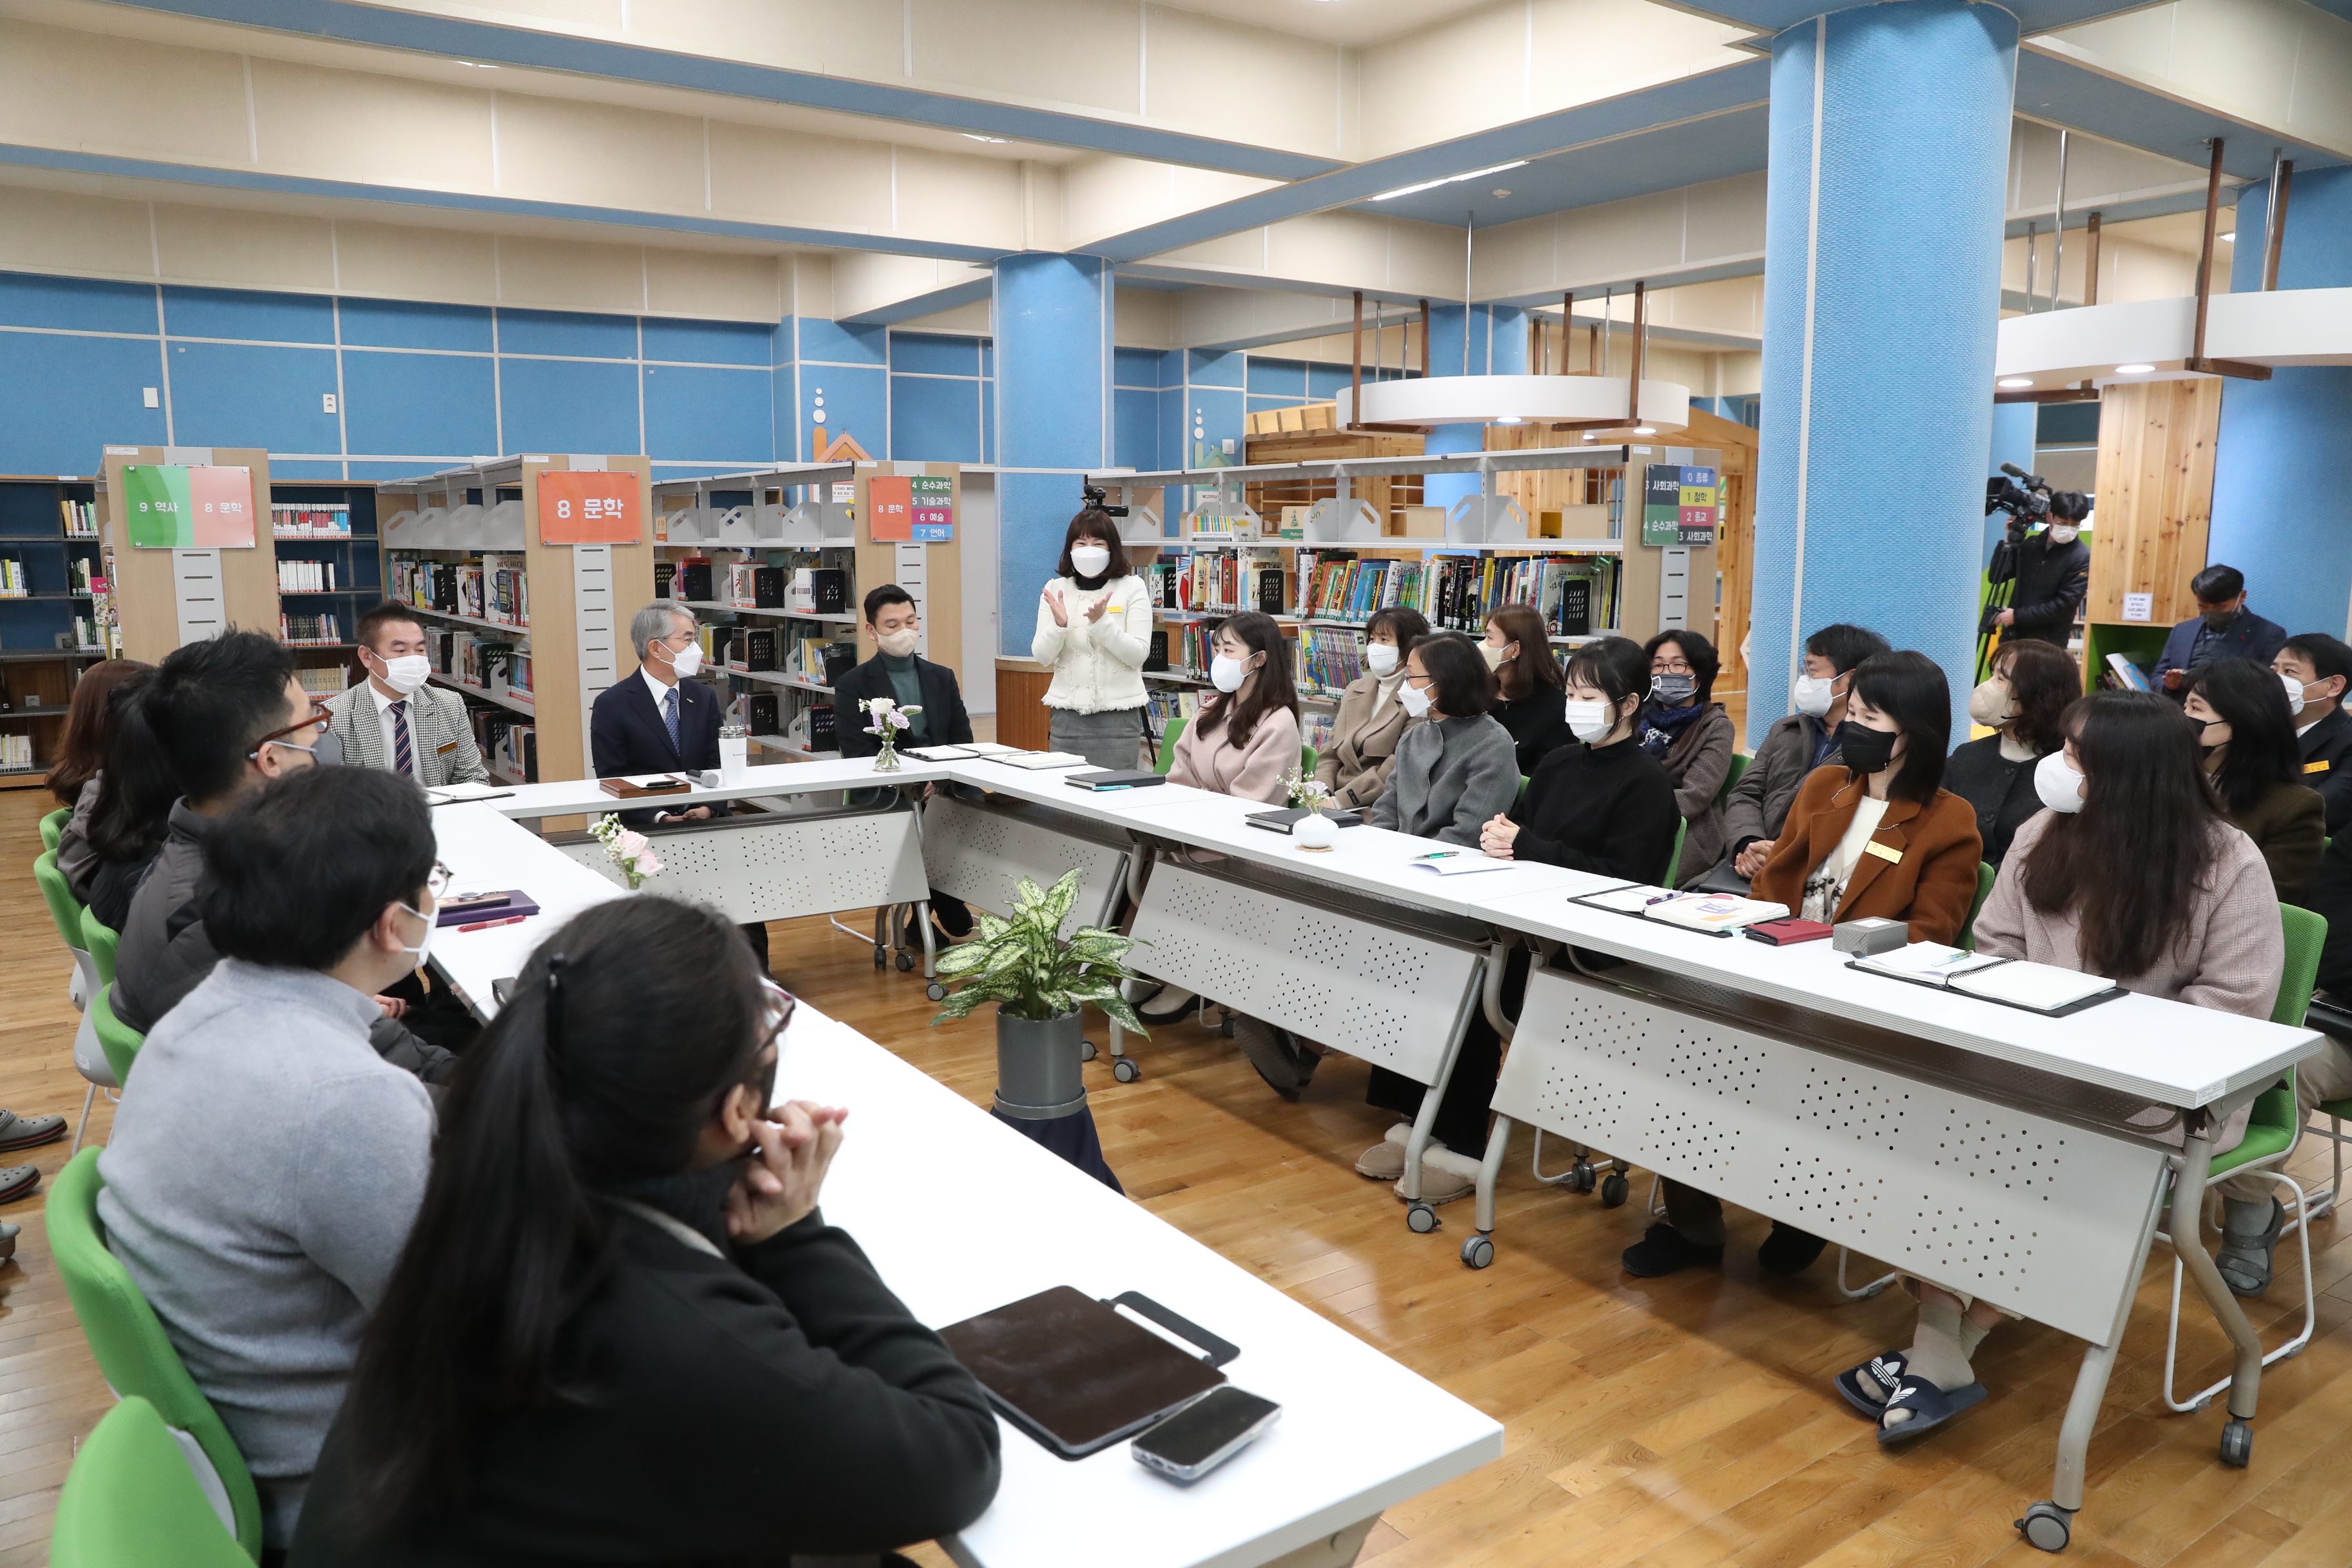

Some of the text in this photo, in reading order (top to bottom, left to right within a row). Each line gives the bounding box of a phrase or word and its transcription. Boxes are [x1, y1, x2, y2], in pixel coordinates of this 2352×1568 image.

[1687, 472, 1709, 484] 0 총류
[912, 480, 951, 490] 4 순수과학
[1645, 480, 1680, 491] 3 사회과학
[912, 496, 951, 506] 5 기술과학
[1687, 492, 1707, 503] 1 철학
[139, 502, 179, 513] 9 역사
[204, 502, 243, 514] 8 문학
[558, 497, 624, 519] 8 문학
[877, 504, 904, 514] 8 문학
[930, 513, 945, 522] 예술
[1687, 511, 1707, 522] 2 종교
[1643, 520, 1679, 531] 4 순수과학
[920, 529, 945, 538] 7 언어
[1679, 531, 1713, 542] 3 사회과학
